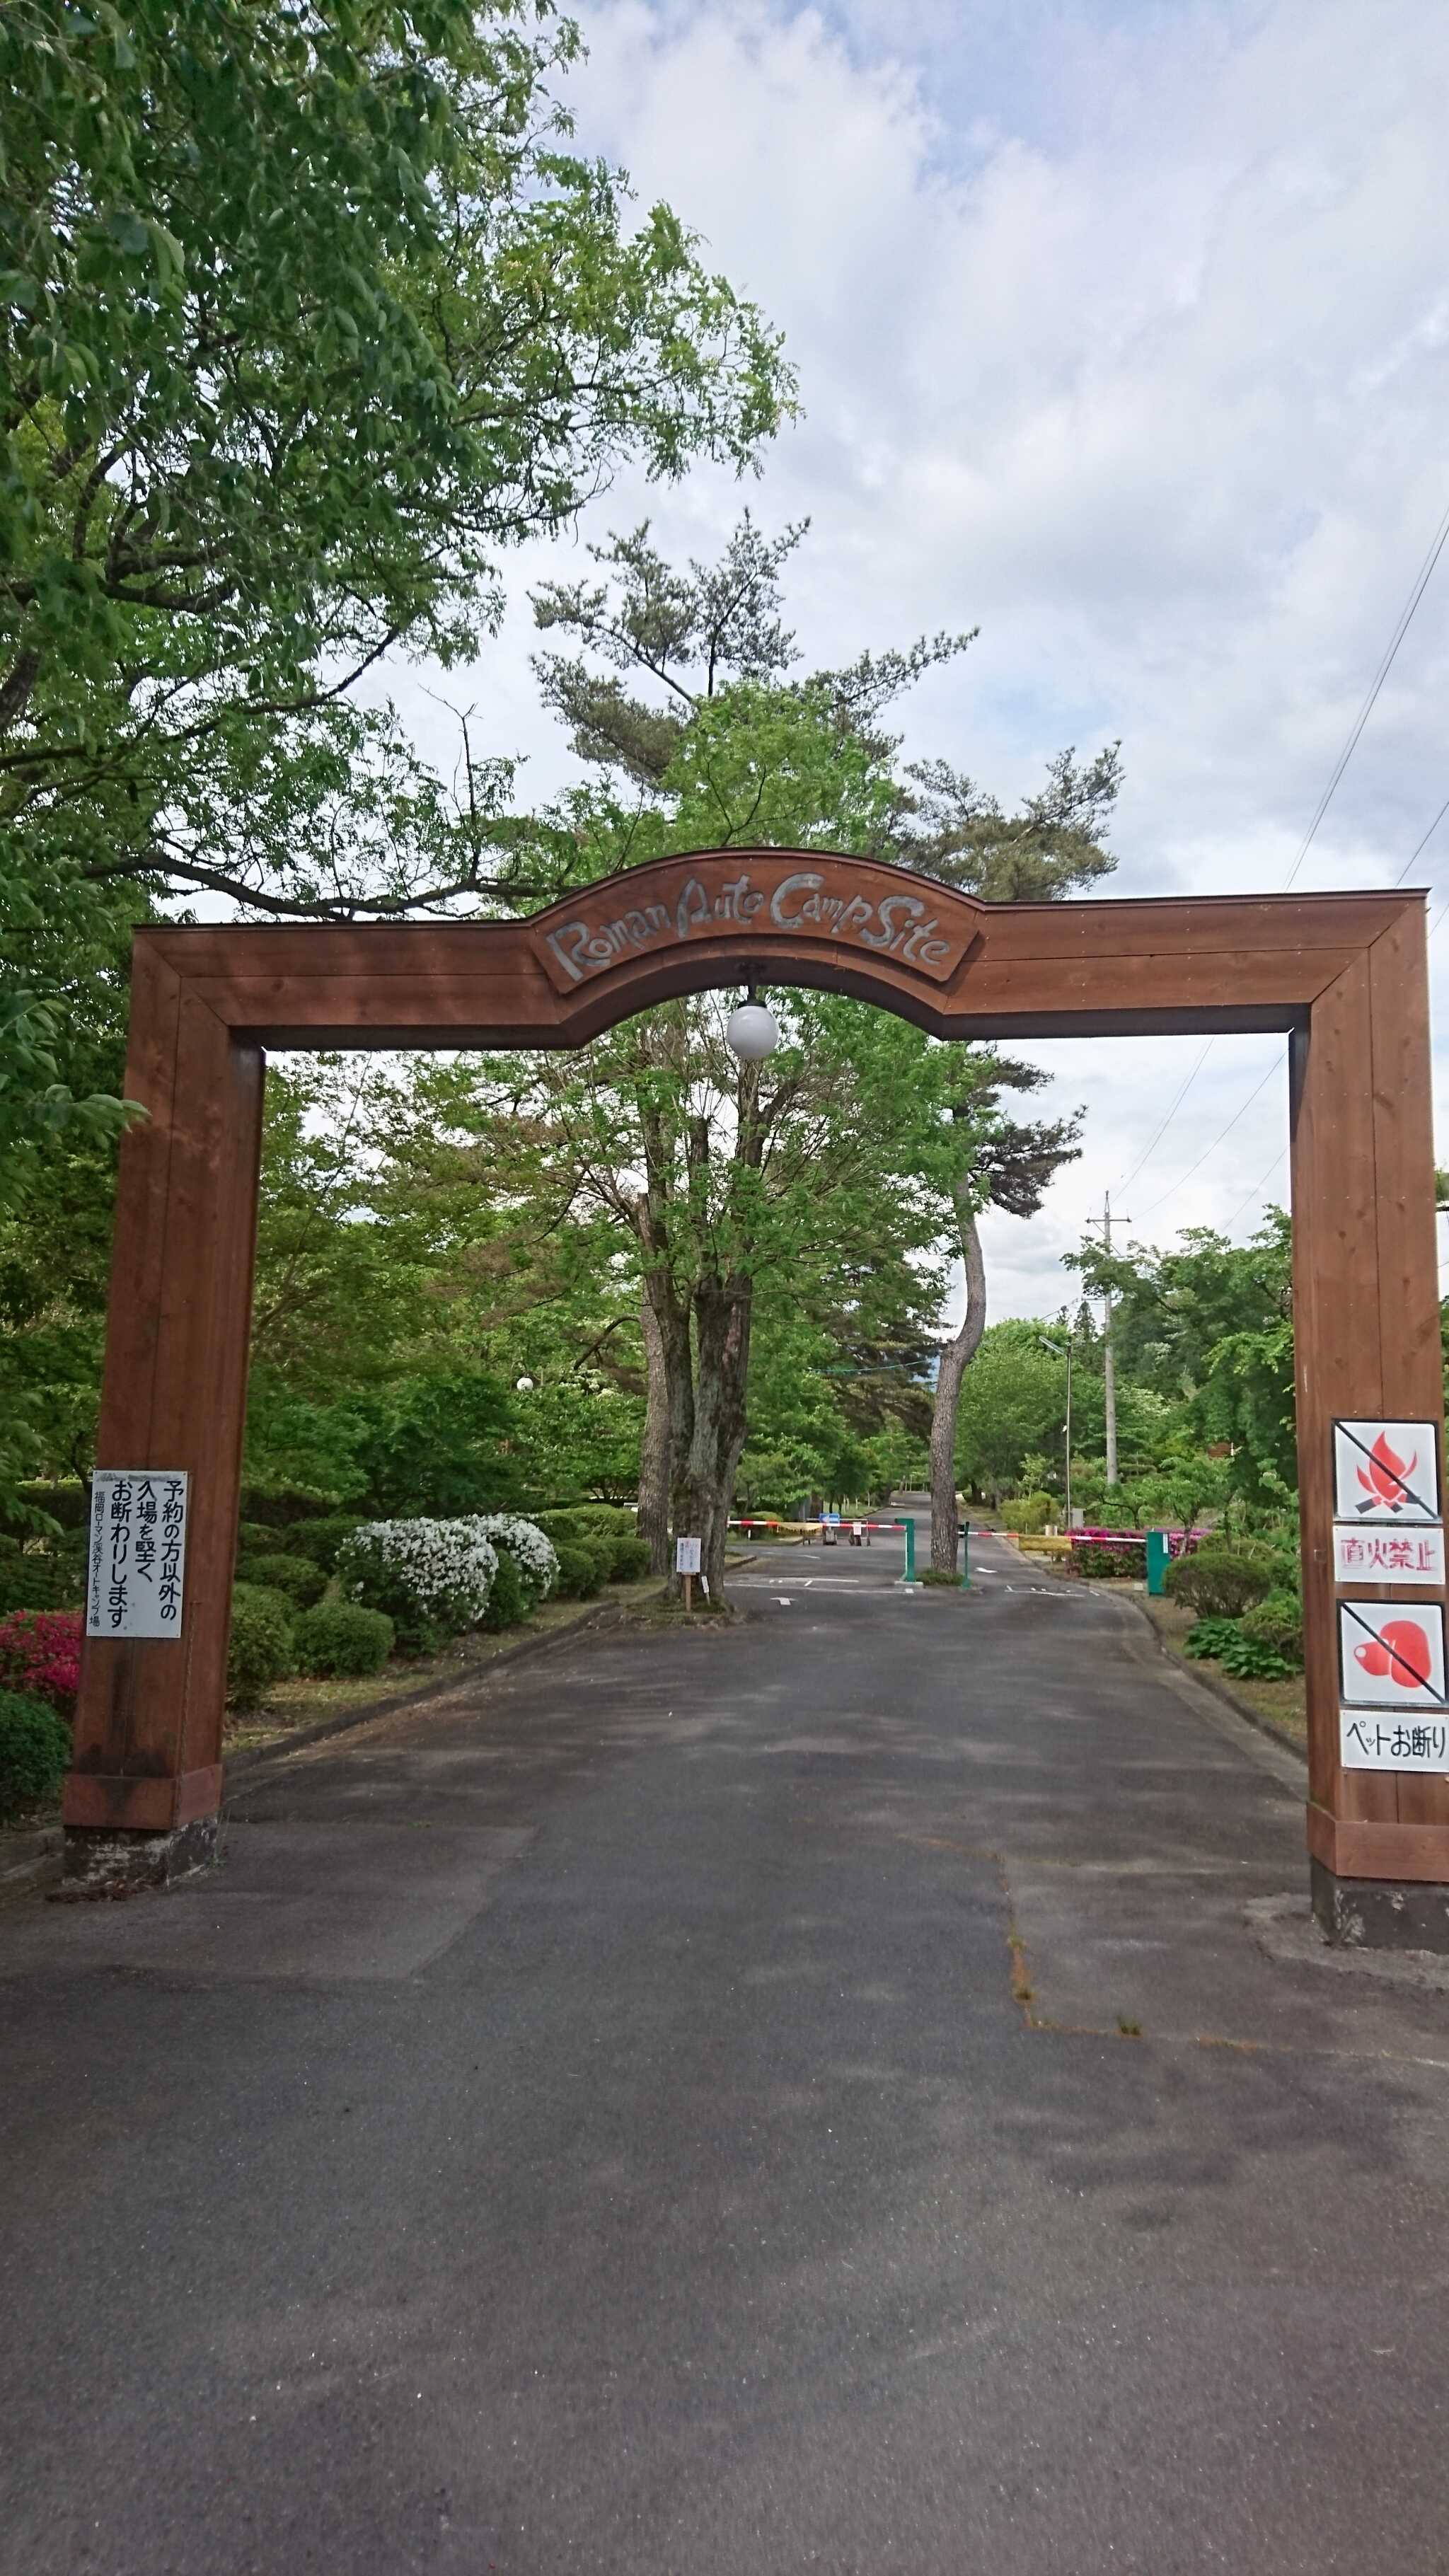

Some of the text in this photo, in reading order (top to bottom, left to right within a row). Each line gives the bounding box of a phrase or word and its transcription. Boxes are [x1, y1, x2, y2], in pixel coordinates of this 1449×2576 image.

[545, 872, 951, 981] Roman Auto Camp Site
[108, 1480, 133, 1628] お断わりします
[135, 1480, 157, 1583] 入場を堅く
[158, 1480, 184, 1620] 予約の方以外の
[1341, 1537, 1438, 1571] 直火禁止
[1346, 1721, 1445, 1759] ペットお断り
